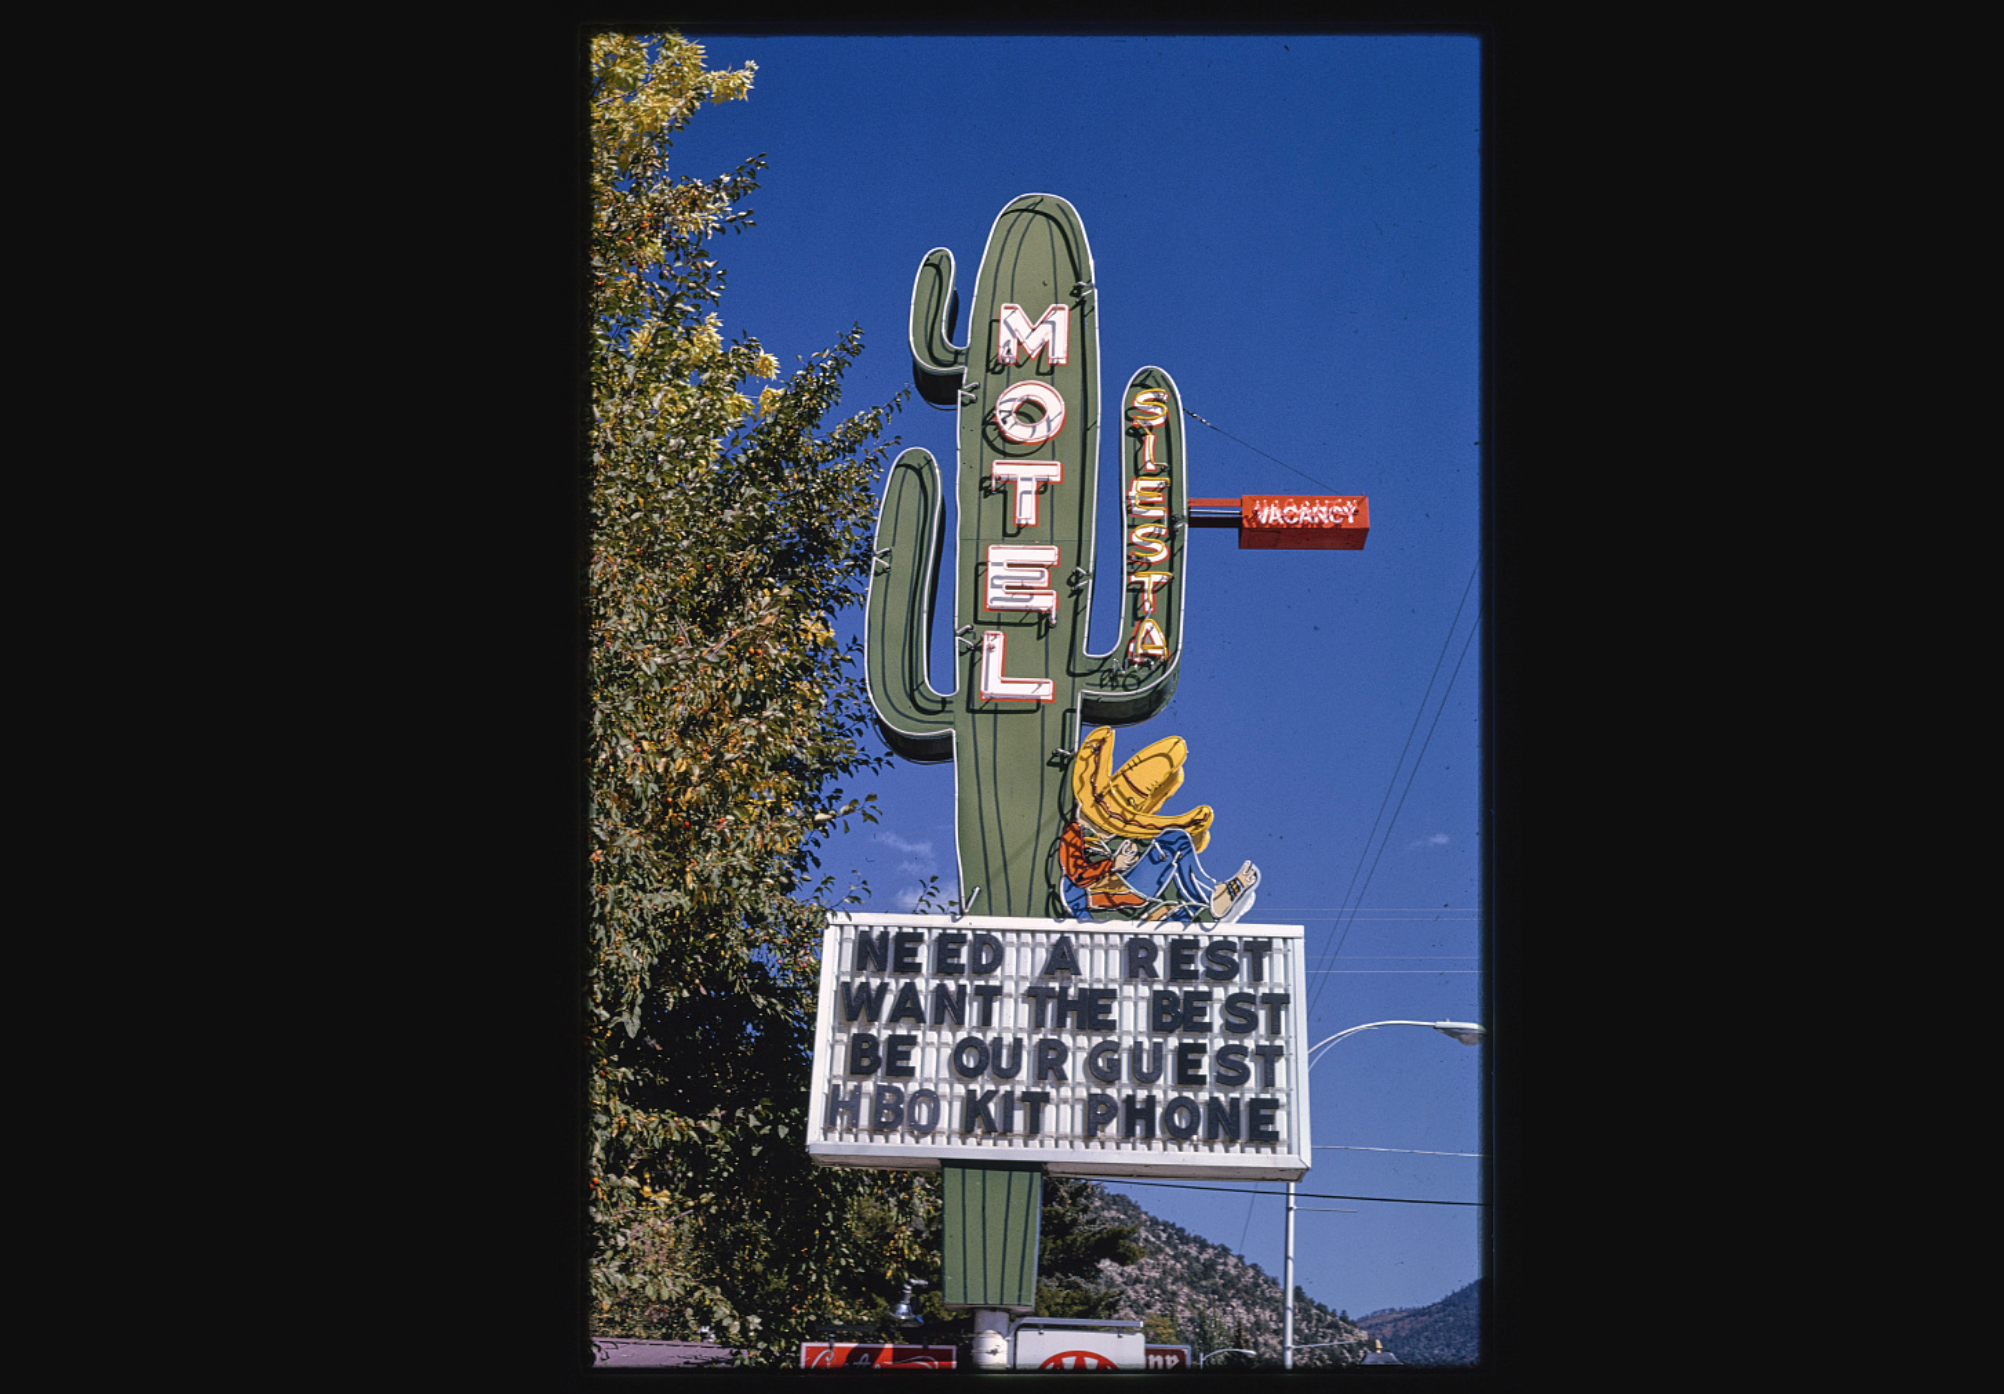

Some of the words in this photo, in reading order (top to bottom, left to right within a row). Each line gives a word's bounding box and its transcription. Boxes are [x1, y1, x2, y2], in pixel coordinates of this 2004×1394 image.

[980, 303, 1069, 702] MOTEL
[1127, 388, 1172, 663] SIESTA
[1254, 500, 1357, 524] VACANCY
[855, 930, 1003, 974] NEED
[1043, 936, 1082, 976] A
[1128, 937, 1271, 982] REST
[840, 981, 1003, 1027] WANT
[1026, 985, 1118, 1031] THE
[1151, 990, 1290, 1035] BEST
[850, 1033, 918, 1076] BE
[953, 1036, 1068, 1081] OUR
[1088, 1040, 1284, 1087] GUEST
[827, 1084, 941, 1133] HBO
[964, 1089, 1050, 1135] KIT
[1087, 1093, 1280, 1142] PHONE
